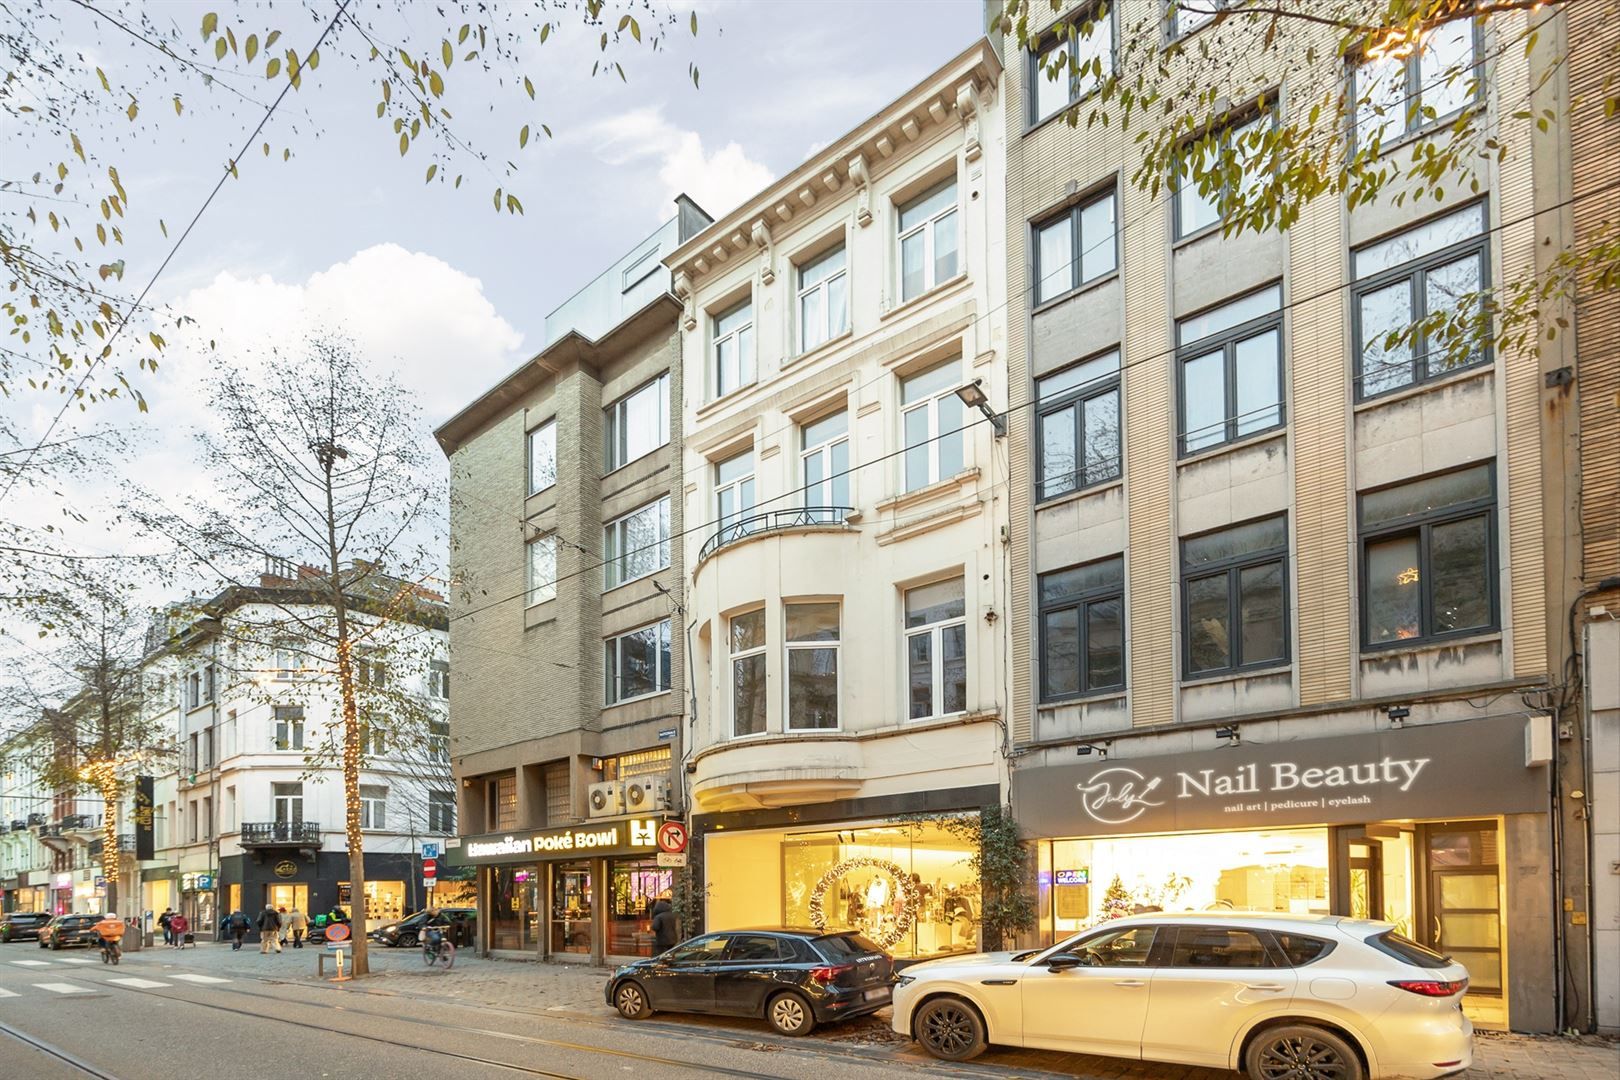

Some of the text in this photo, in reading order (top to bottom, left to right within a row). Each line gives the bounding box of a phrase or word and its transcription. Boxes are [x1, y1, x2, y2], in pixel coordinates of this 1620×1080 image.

[1176, 757, 1430, 798] Nail Beauty
[1224, 795, 1371, 813] nail art pedicure eyelash
[534, 831, 573, 851] Poké
[575, 828, 617, 848] Bowl
[199, 877, 209, 887] P
